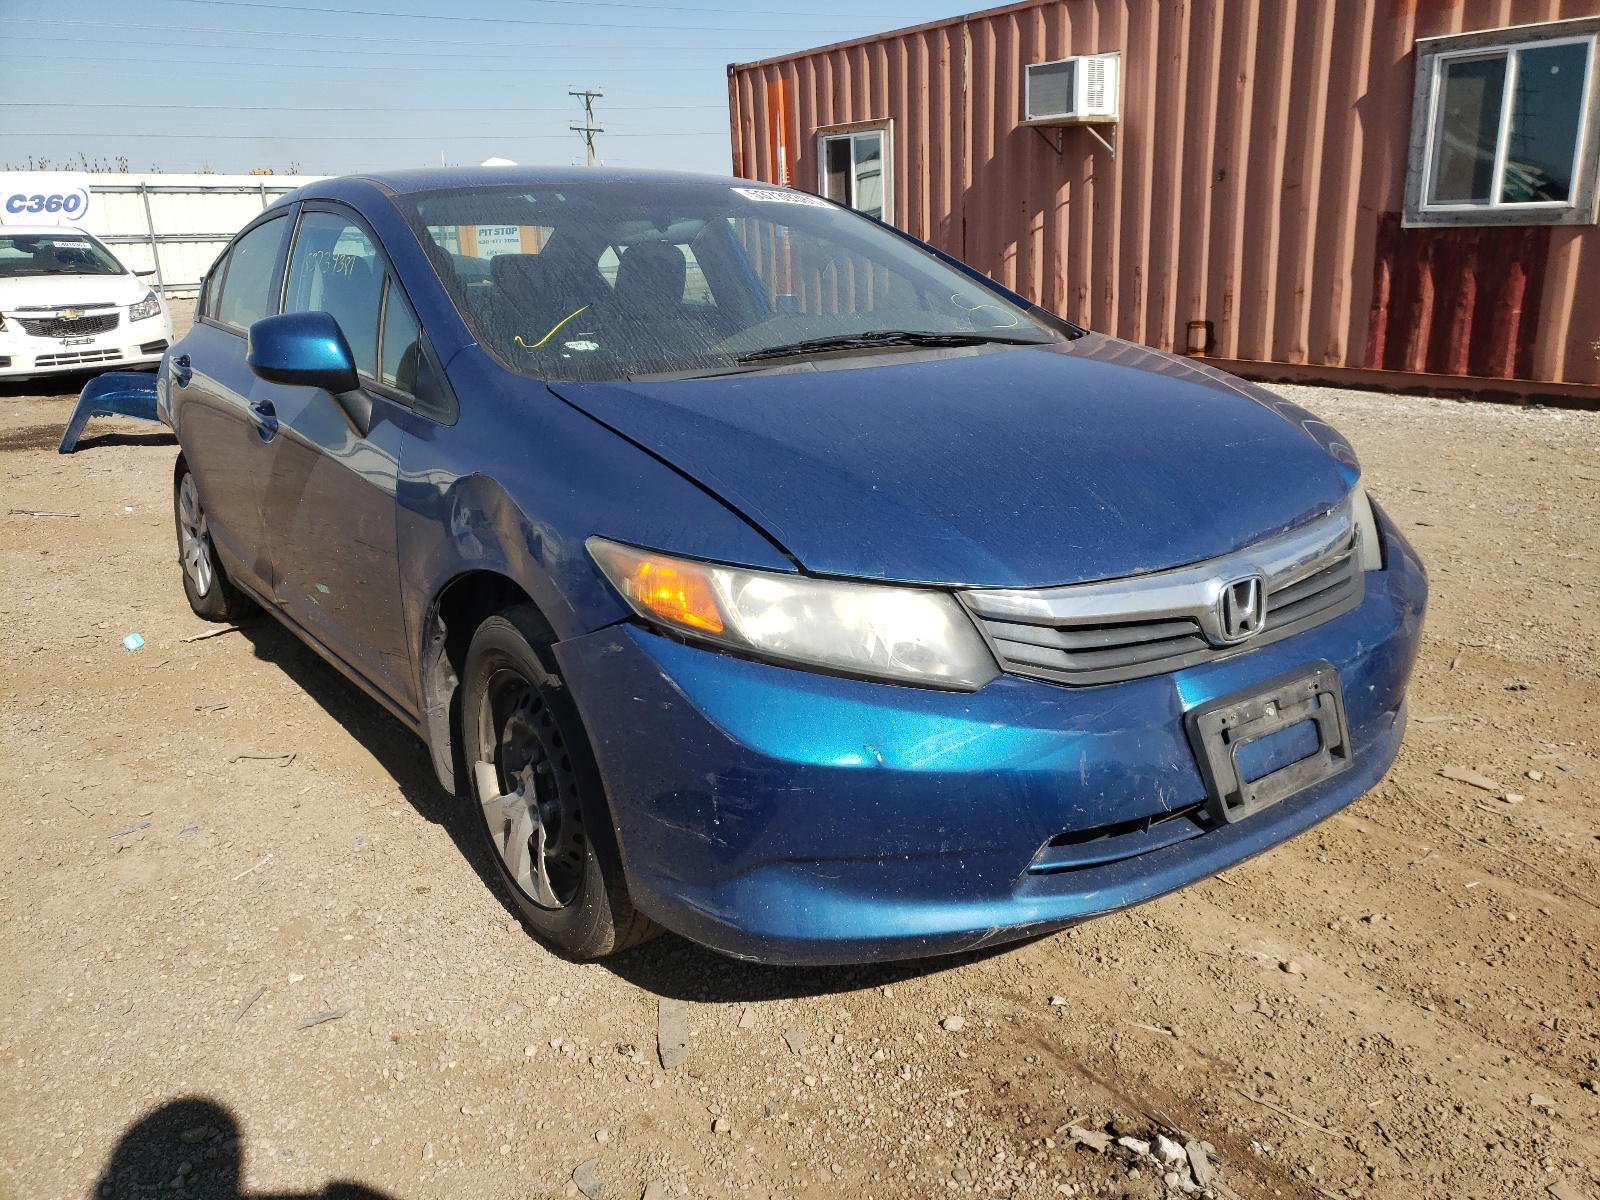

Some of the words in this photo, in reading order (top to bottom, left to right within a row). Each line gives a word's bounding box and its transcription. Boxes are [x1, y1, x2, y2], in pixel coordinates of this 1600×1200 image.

[6, 193, 81, 214] C360
[478, 228, 493, 237] PIT
[494, 227, 518, 236] STOP
